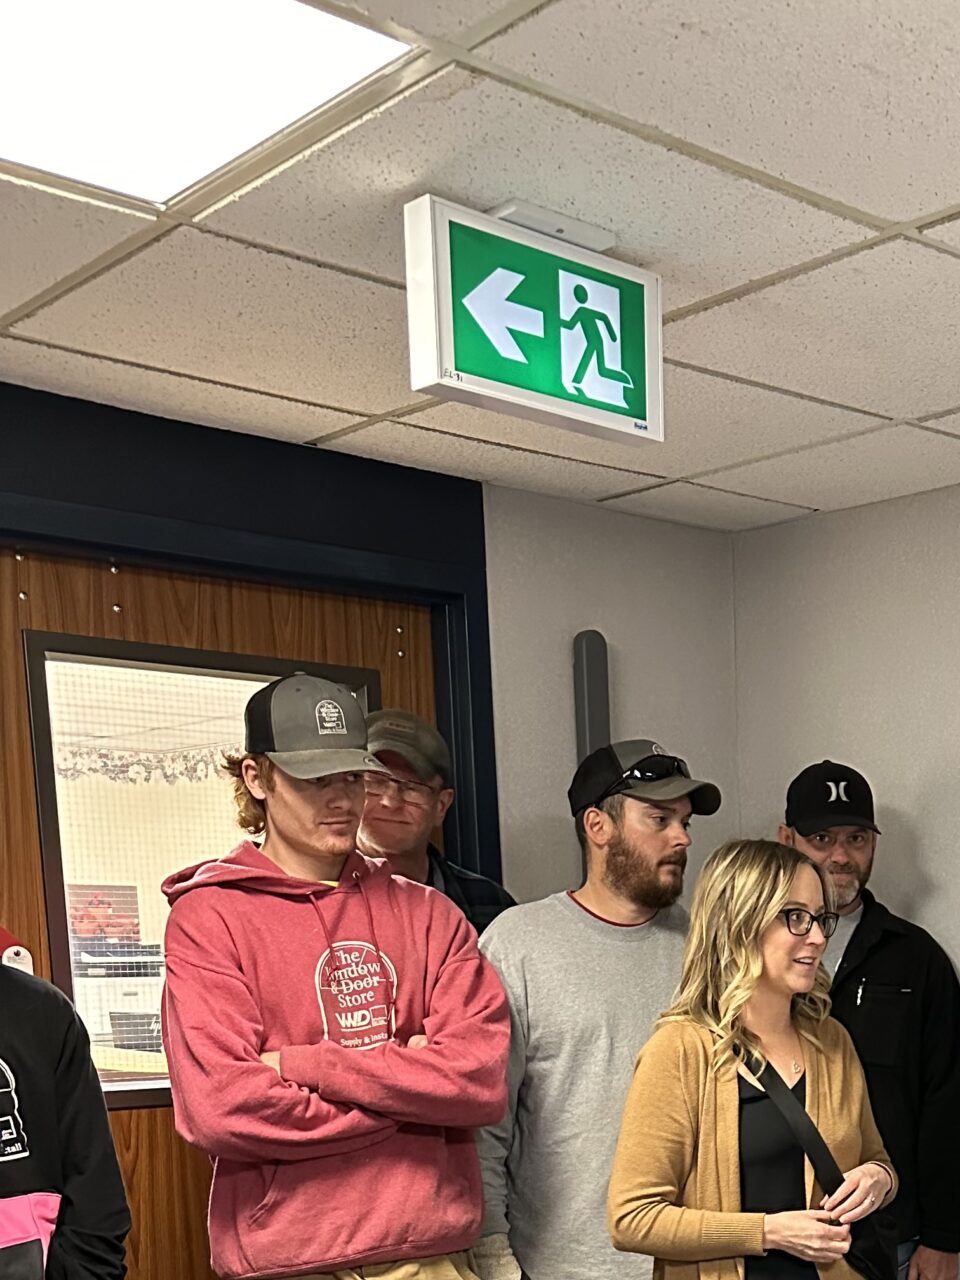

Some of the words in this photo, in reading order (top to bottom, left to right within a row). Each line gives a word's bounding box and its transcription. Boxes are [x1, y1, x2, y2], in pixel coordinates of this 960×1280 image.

[341, 975, 380, 994] Door
[338, 990, 375, 1008] Store
[341, 1038, 362, 1047] Supply
